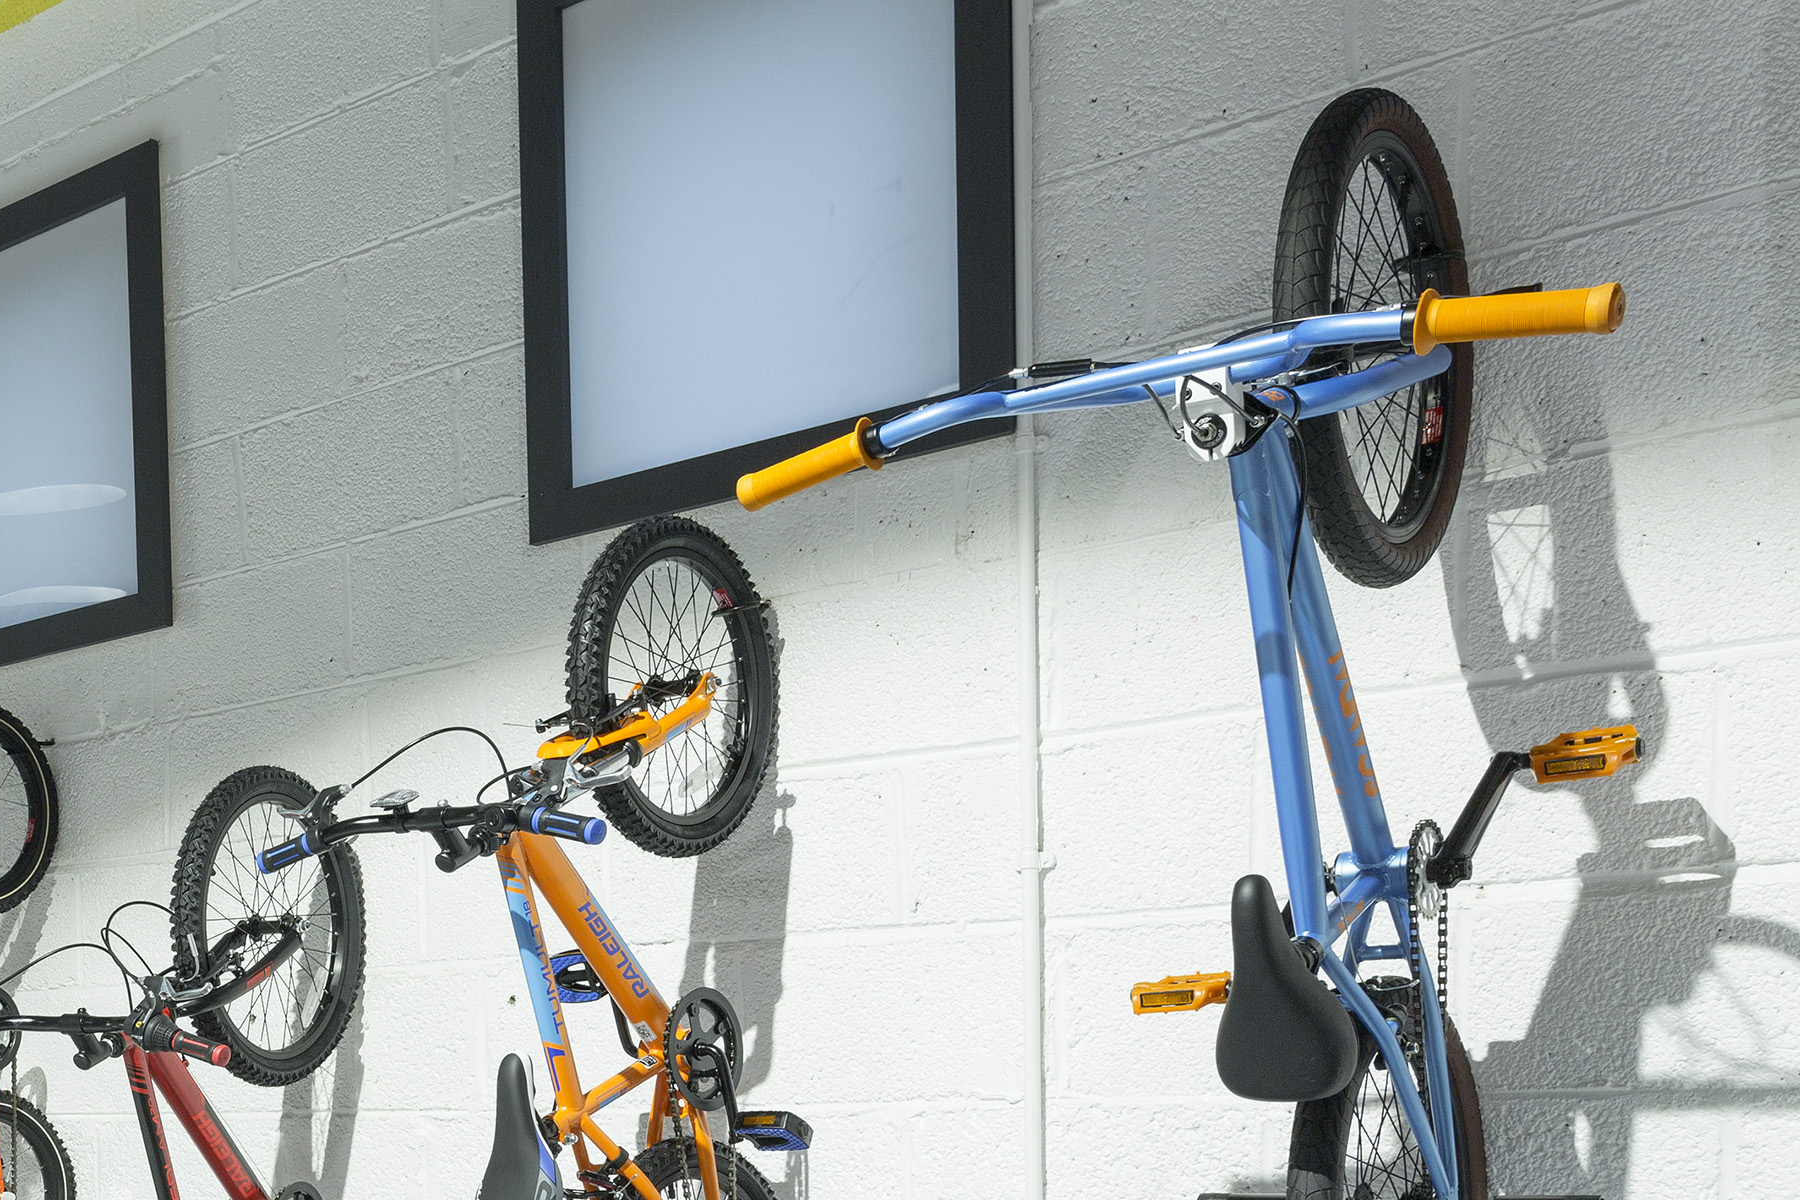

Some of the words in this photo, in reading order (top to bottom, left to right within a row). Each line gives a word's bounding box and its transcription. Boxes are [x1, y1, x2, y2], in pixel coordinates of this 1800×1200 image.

[523, 900, 533, 917] 18
[578, 901, 649, 999] RALEIGH
[528, 920, 565, 1035] TUMULT
[192, 1110, 257, 1199] RALEIGH
